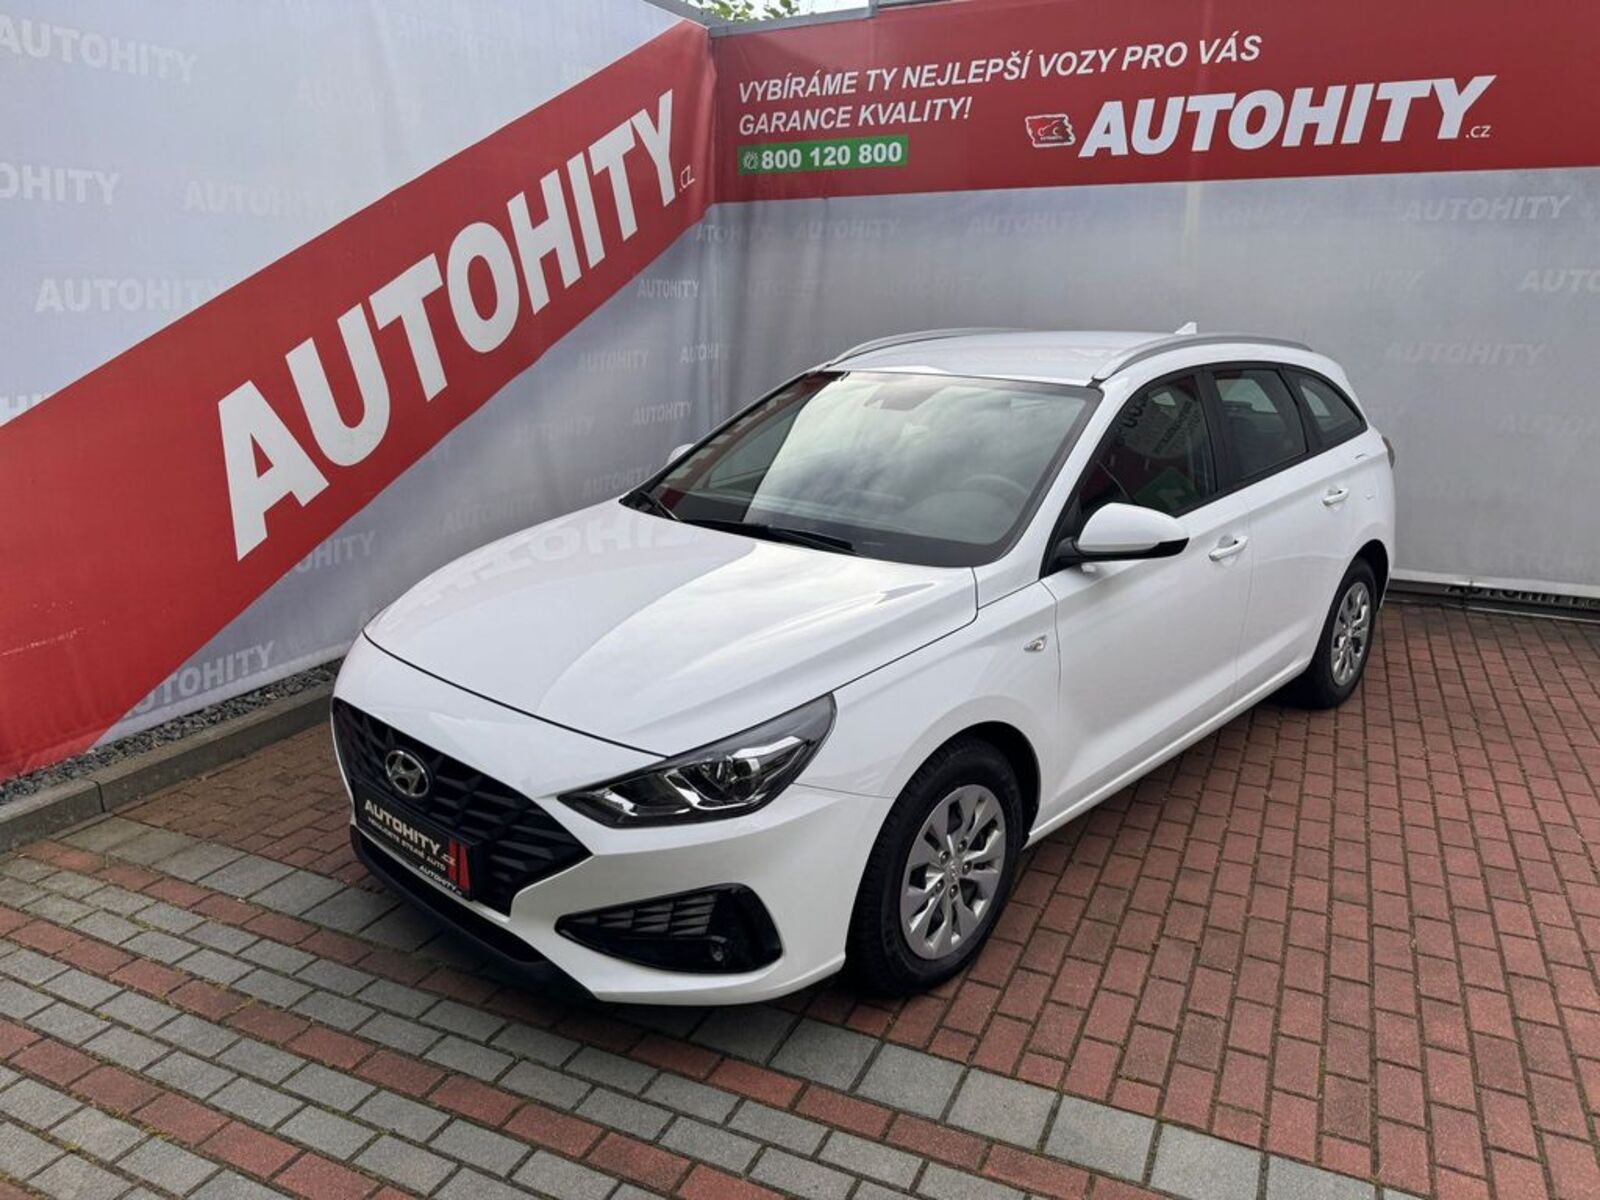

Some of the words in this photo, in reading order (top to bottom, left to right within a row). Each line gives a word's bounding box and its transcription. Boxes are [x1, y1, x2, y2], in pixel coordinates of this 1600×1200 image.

[739, 70, 858, 103] VYBÍRÁME
[866, 68, 898, 92] TY
[901, 50, 1033, 89] NEJLEPŠÍ
[1038, 47, 1117, 78] VOZY
[1121, 41, 1188, 71] PRO
[1199, 30, 1262, 65] VÁS
[739, 106, 852, 136] GARANCE
[857, 96, 973, 126] KVALITY!
[1078, 74, 1497, 158] AUTOHITY
[761, 149, 802, 170] 800
[809, 146, 851, 167] 120
[858, 142, 902, 164] 800
[217, 88, 676, 563] AUTOHITY
[365, 799, 441, 856] AUTOHITY
